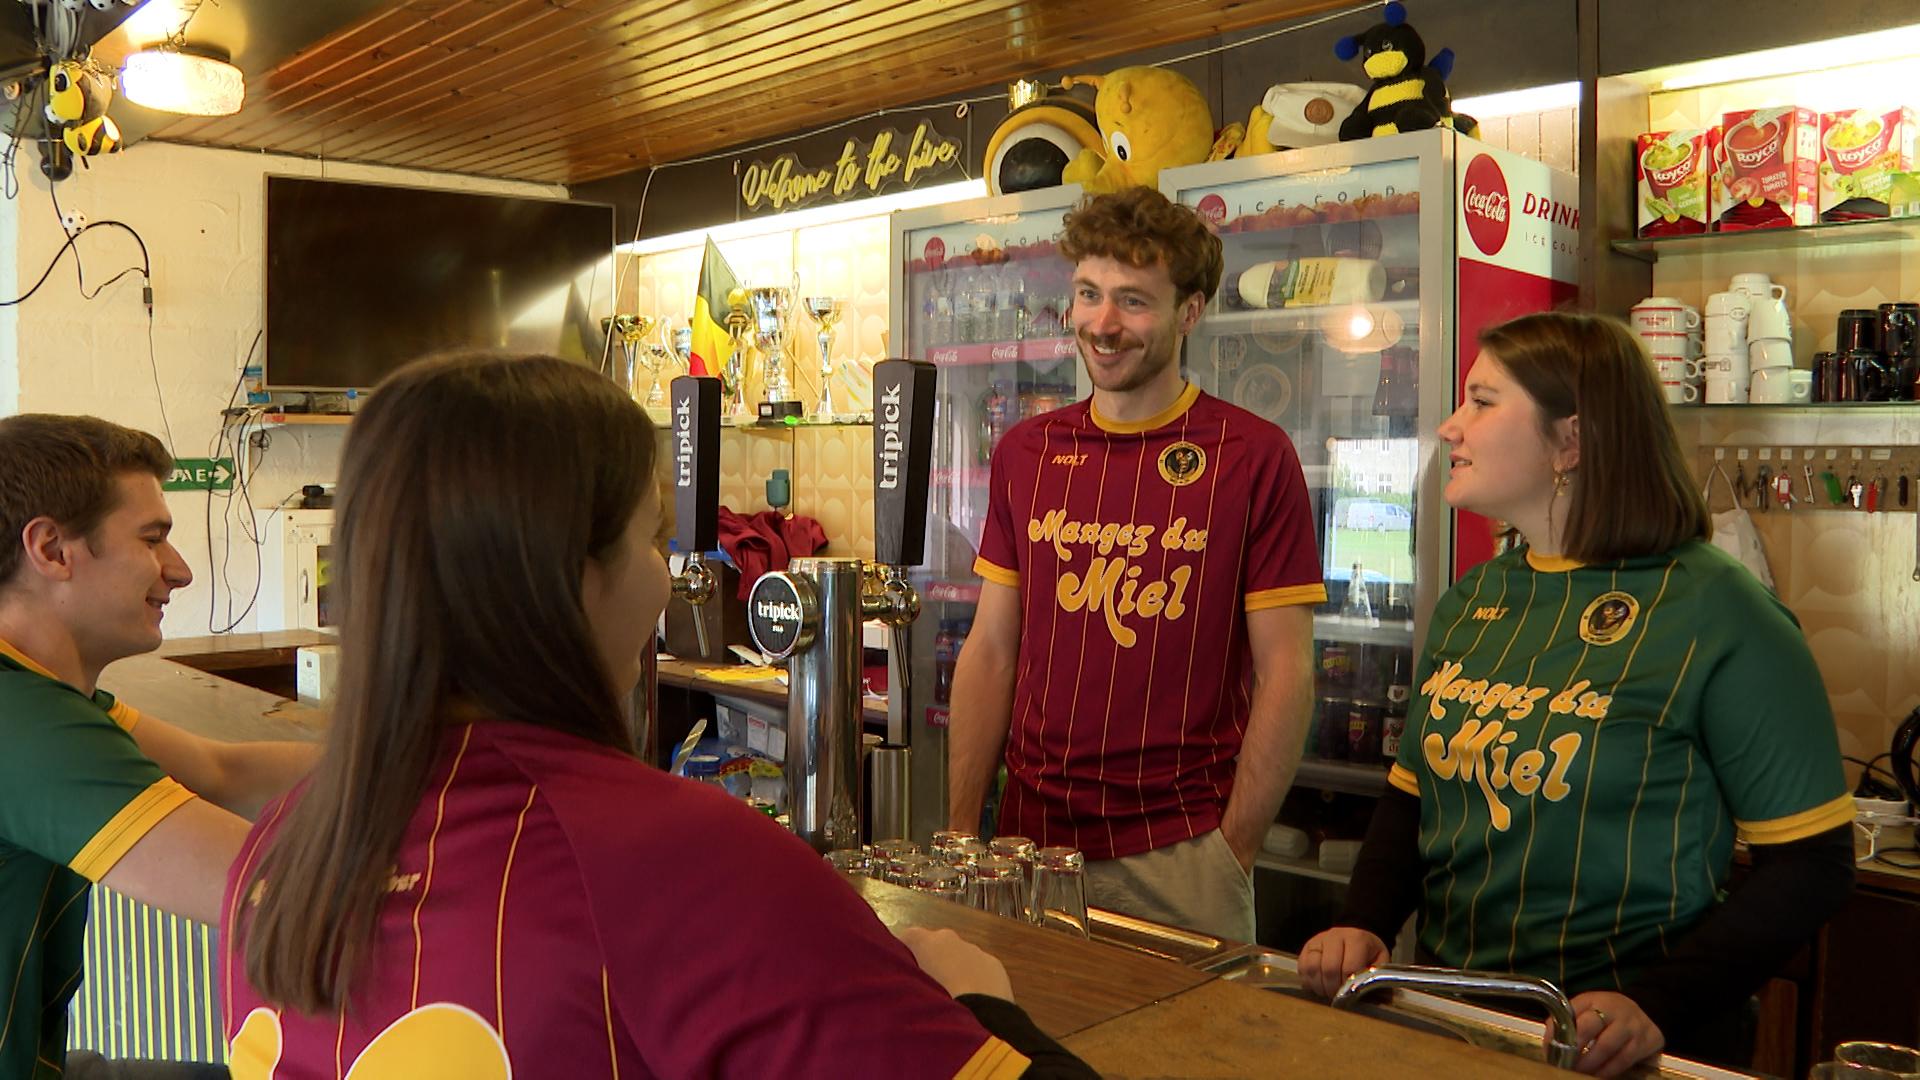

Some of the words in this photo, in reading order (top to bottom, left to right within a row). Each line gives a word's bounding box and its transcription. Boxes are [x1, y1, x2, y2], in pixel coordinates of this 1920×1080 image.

[742, 157, 832, 209] Welcome
[833, 141, 861, 196] to
[865, 131, 902, 190] the
[904, 124, 957, 182] hive
[1525, 231, 1546, 246] ICE
[1552, 241, 1580, 255] COL
[676, 395, 694, 487] tripick
[879, 383, 903, 489] tripick
[1051, 454, 1089, 467] NOLT
[1028, 509, 1155, 562] Mangez
[1161, 516, 1209, 552] du
[757, 601, 800, 622] tripick
[1057, 557, 1192, 648] Miel
[1472, 607, 1509, 620] NOLT
[1421, 661, 1550, 720] Mangez
[1549, 679, 1613, 719] du
[1424, 719, 1582, 831] Miel
